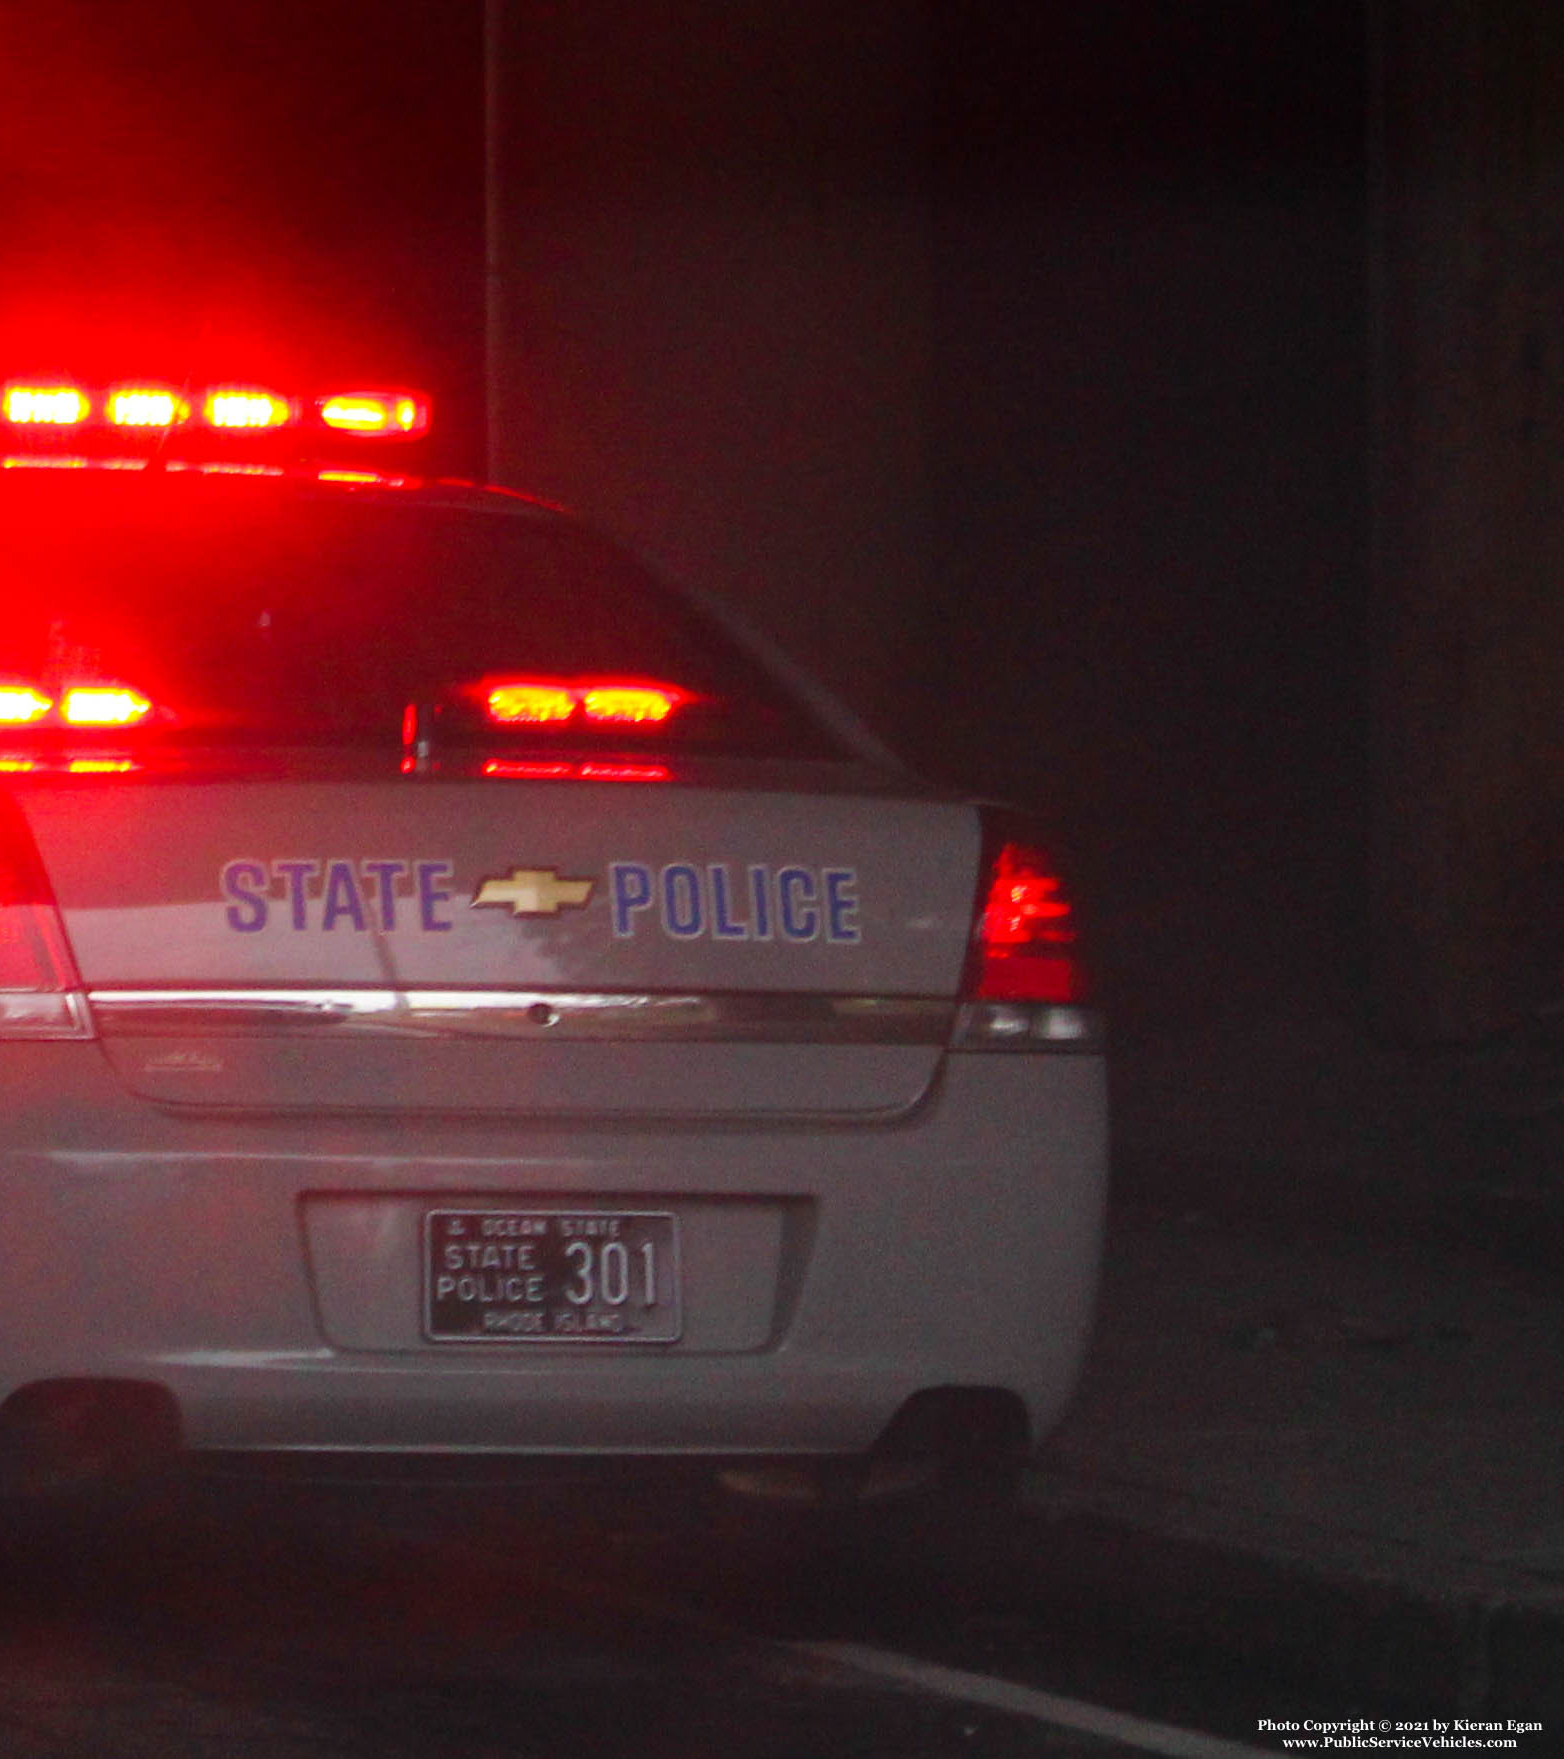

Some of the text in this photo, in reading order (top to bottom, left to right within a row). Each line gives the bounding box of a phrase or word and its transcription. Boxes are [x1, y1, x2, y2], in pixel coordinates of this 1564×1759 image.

[222, 858, 862, 945] STATE POLICE
[481, 1218, 621, 1238] OCEAN STATE
[444, 1246, 537, 1271] STATE
[564, 1240, 656, 1306] 301
[436, 1276, 545, 1302] POLICE
